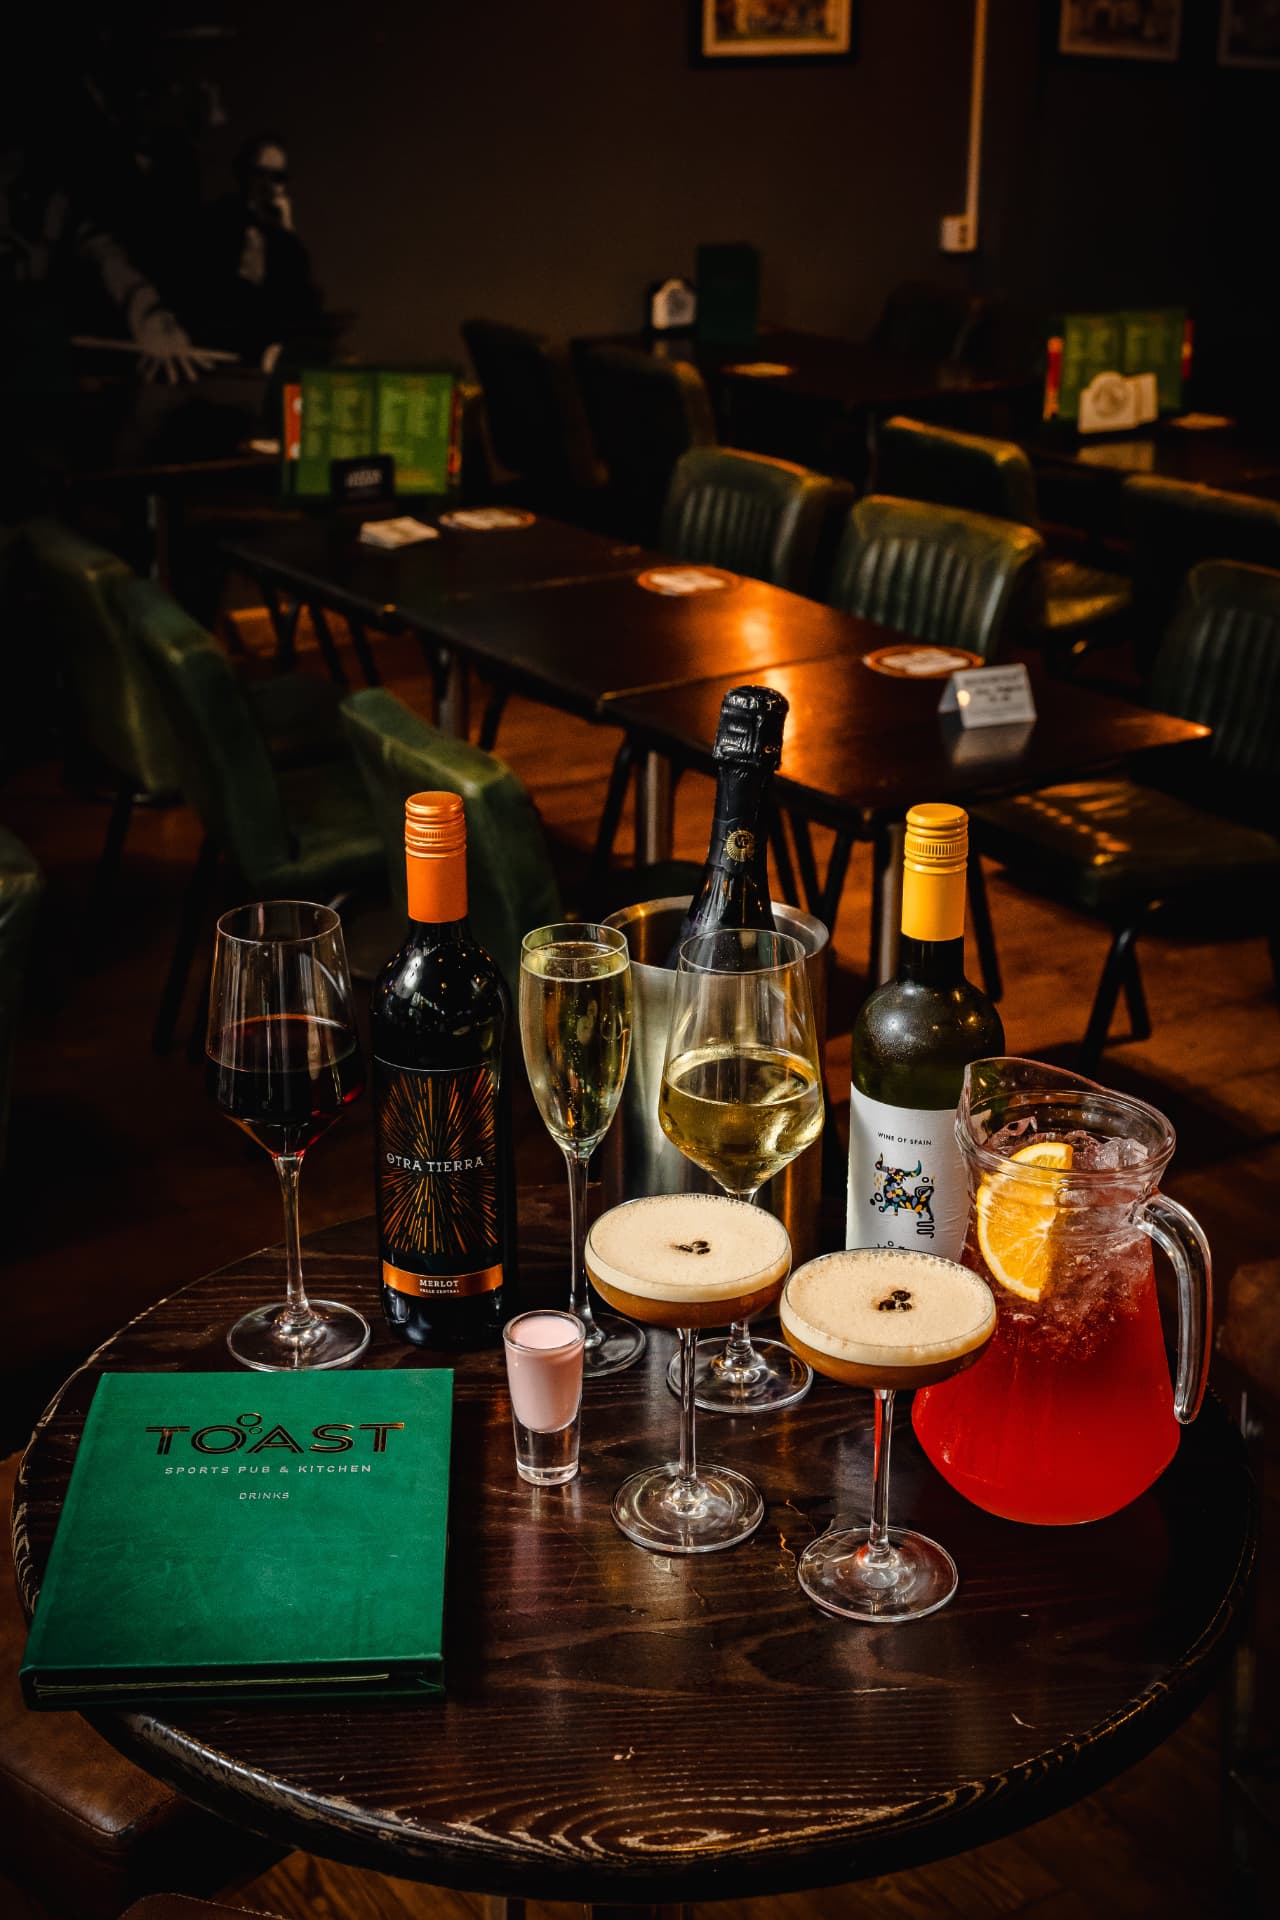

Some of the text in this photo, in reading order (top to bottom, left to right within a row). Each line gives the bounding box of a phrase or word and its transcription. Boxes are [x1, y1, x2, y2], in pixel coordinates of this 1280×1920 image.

[878, 1131, 895, 1141] WINE
[386, 1152, 484, 1172] OTRA TIERRA
[419, 1279, 459, 1288] MERLOT
[145, 1422, 405, 1456] TOAST
[164, 1464, 372, 1475] SPORTS PUB & KITCHEN
[239, 1492, 290, 1500] DRINKS
